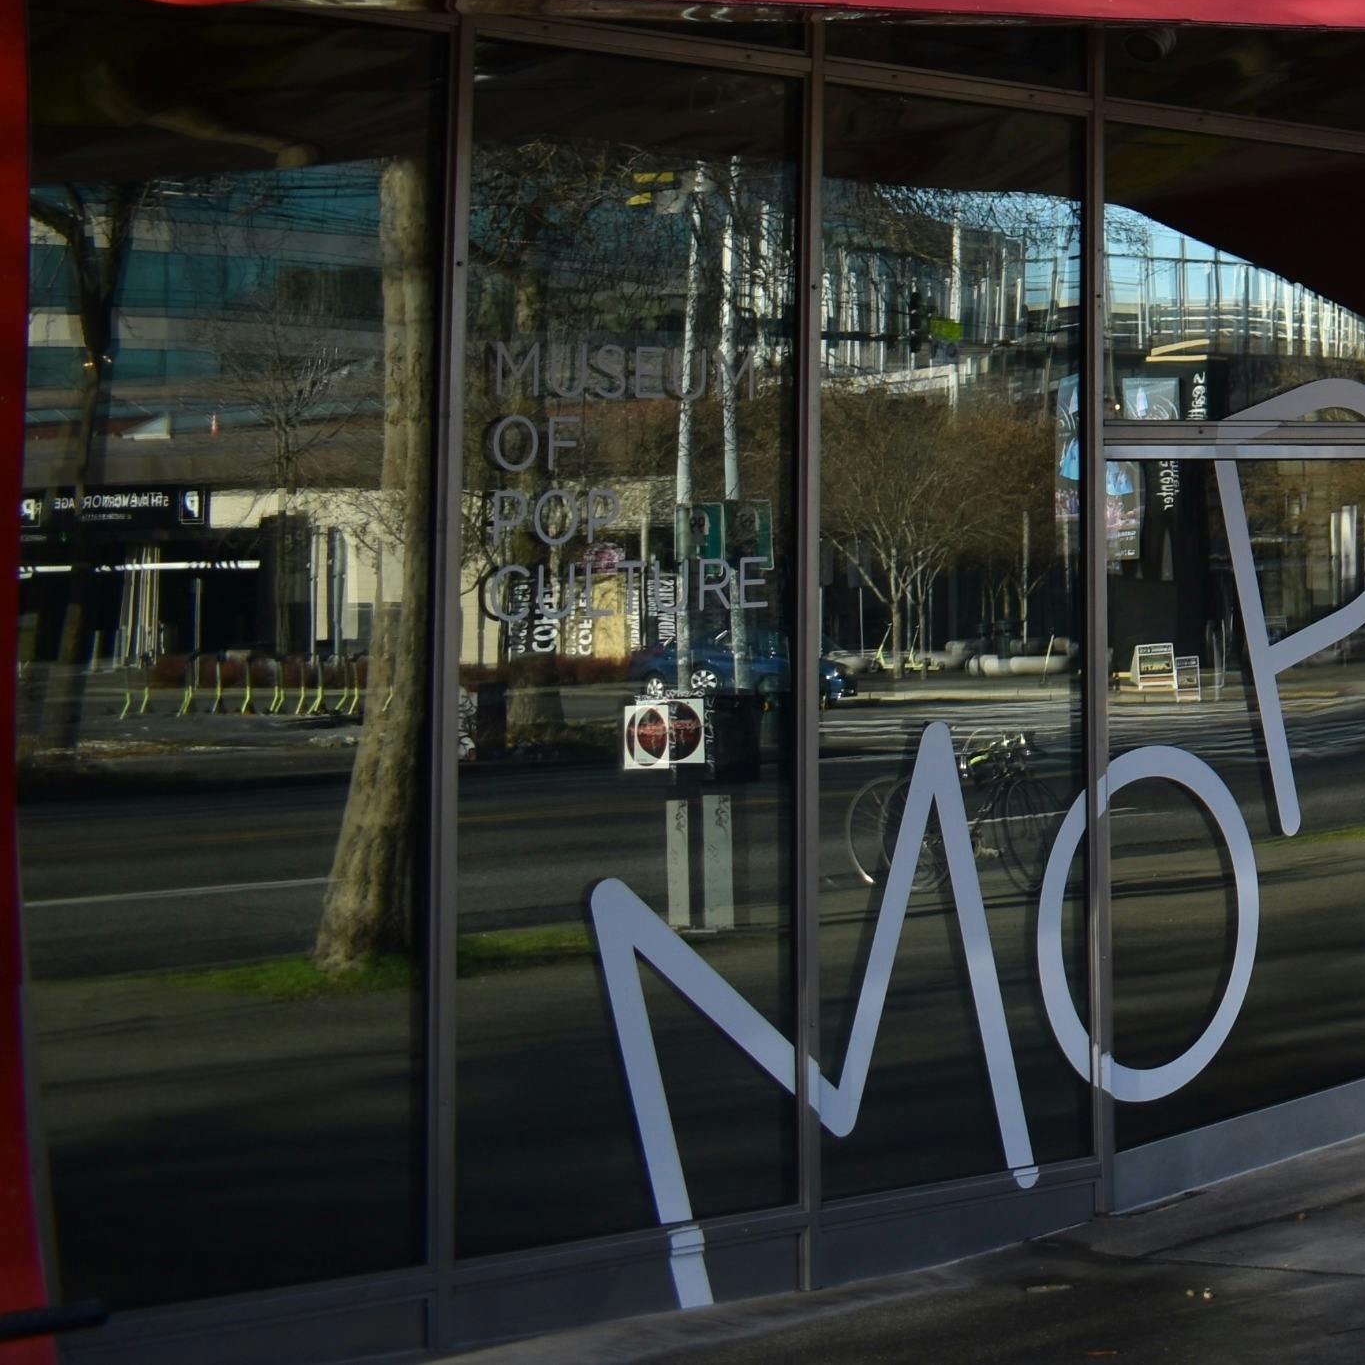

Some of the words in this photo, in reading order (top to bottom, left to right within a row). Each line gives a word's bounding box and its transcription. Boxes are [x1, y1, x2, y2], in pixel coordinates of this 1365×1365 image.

[495, 341, 757, 401] MUSEUM
[493, 415, 580, 471] OF
[492, 488, 621, 546] POP
[489, 556, 771, 623] CULTURE
